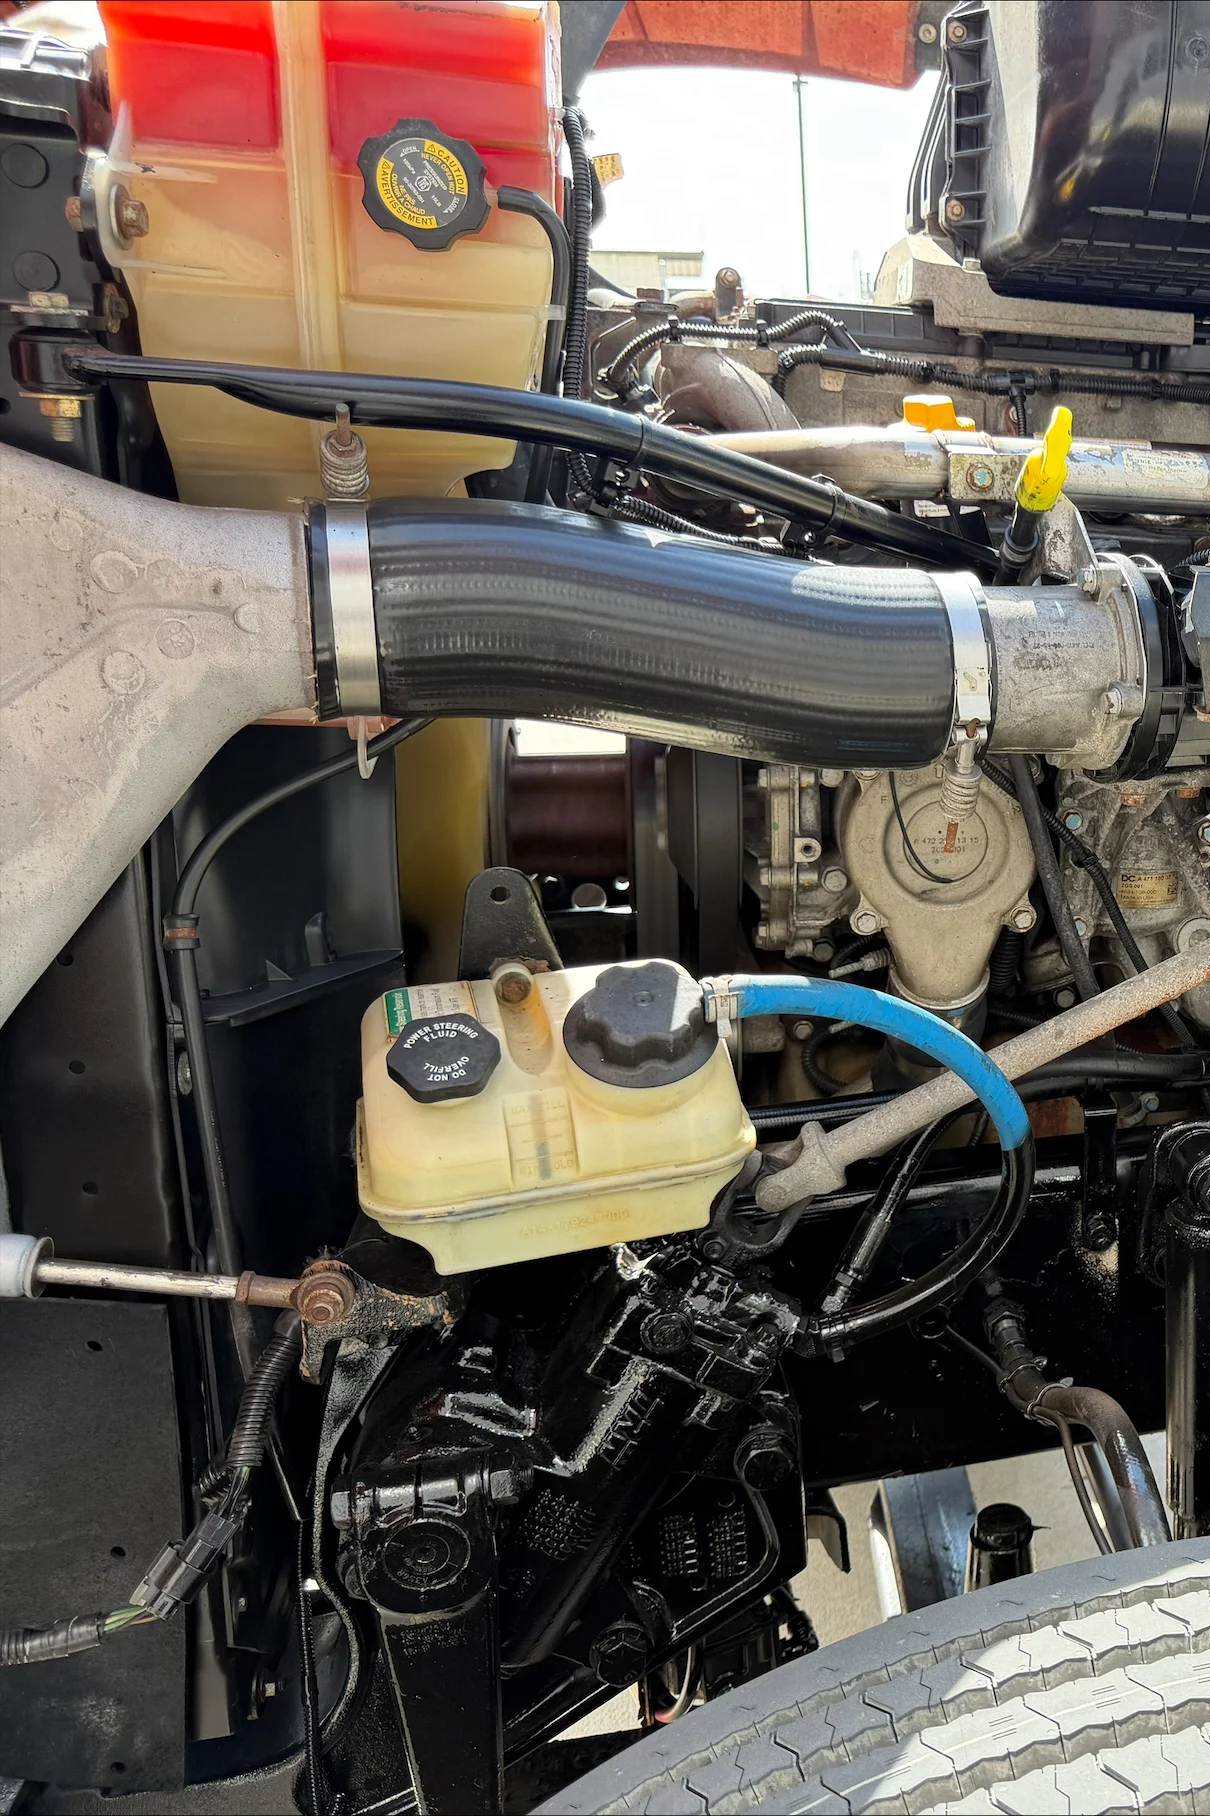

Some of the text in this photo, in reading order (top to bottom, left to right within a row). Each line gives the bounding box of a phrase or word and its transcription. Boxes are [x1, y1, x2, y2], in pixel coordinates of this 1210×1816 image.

[421, 153, 441, 166] NEVER
[441, 163, 453, 181] OPEN
[438, 150, 464, 193] CAUTION
[382, 170, 434, 225] AVERTISSEMENT
[404, 201, 426, 214] CHAUD
[403, 1022, 479, 1049] POWER STEERING
[423, 1030, 457, 1042] FLUID
[423, 1056, 470, 1073] OVERFILL
[452, 1069, 467, 1078] DO
